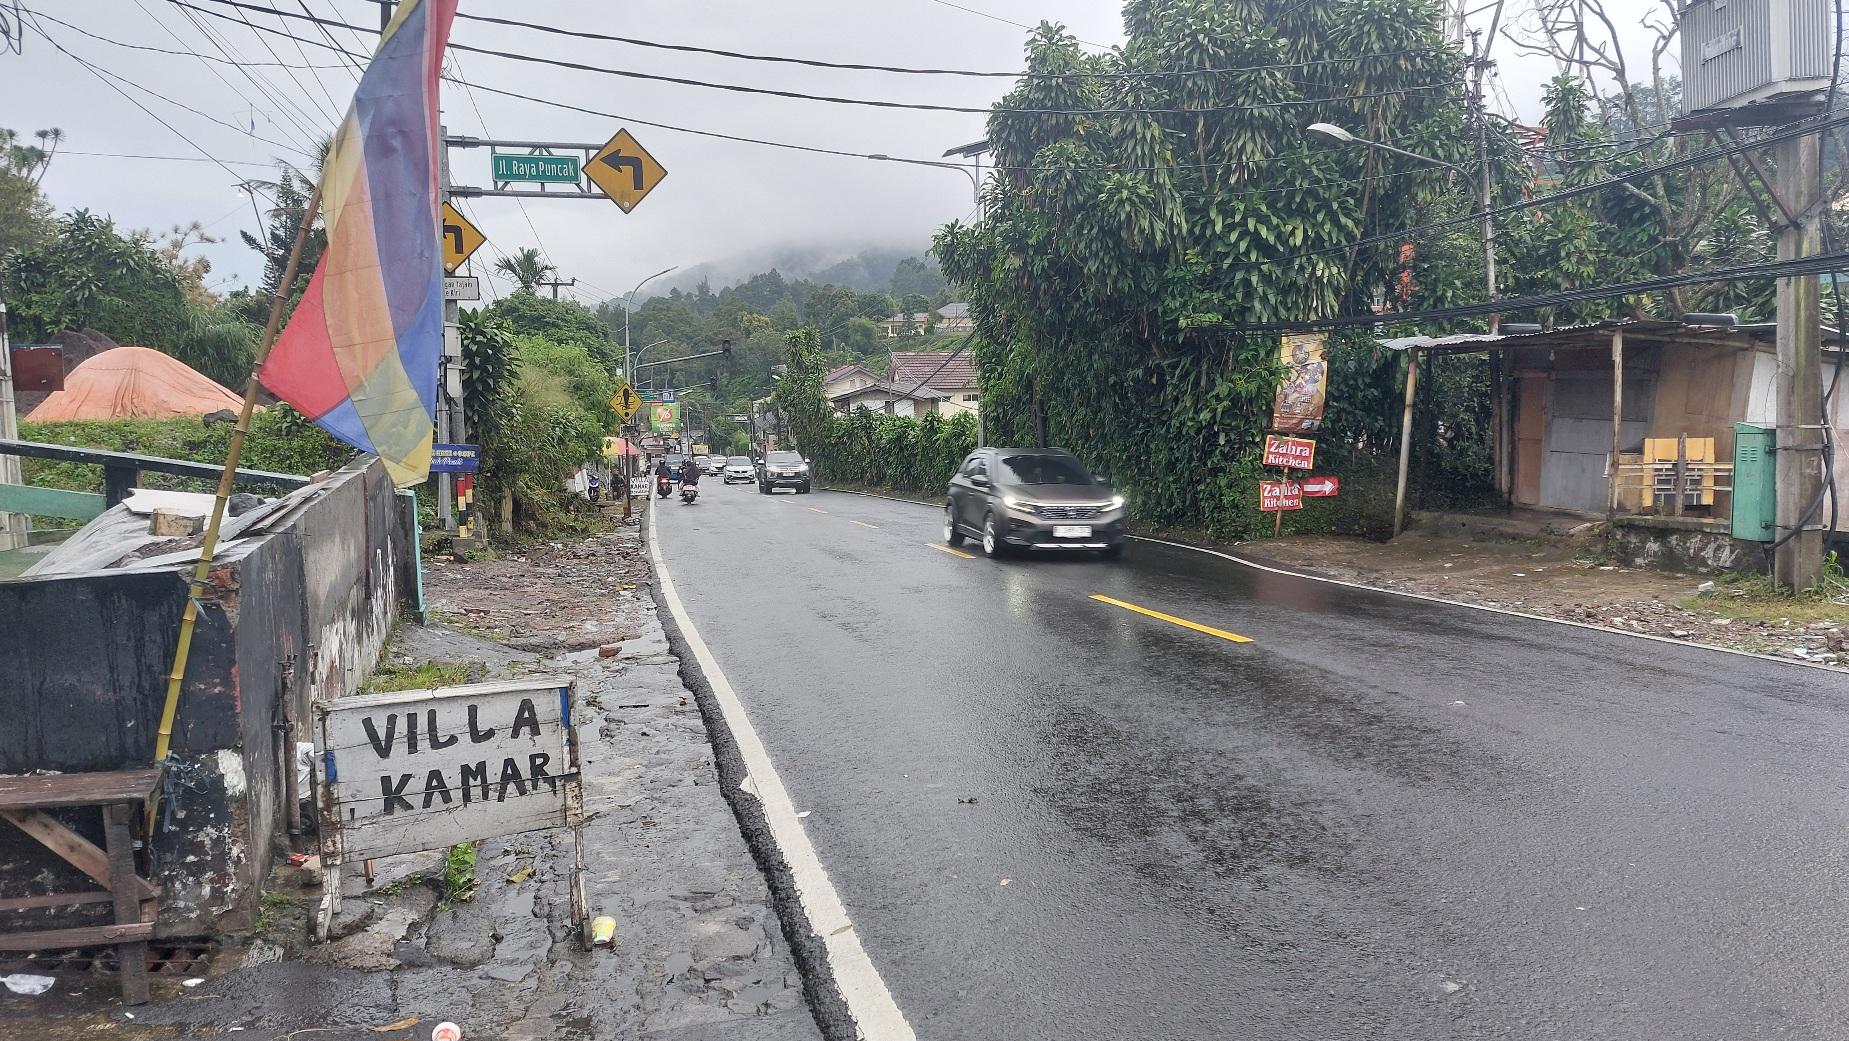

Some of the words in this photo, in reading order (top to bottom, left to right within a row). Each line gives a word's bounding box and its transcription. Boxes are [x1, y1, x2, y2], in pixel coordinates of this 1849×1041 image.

[498, 160, 510, 175] Jl.
[513, 161, 536, 179] Raya
[539, 161, 574, 177] Puncak
[1269, 441, 1310, 456] Zahra
[1268, 454, 1308, 468] Kitchen
[361, 698, 541, 759] VILLA
[380, 752, 558, 816] KAMAR
